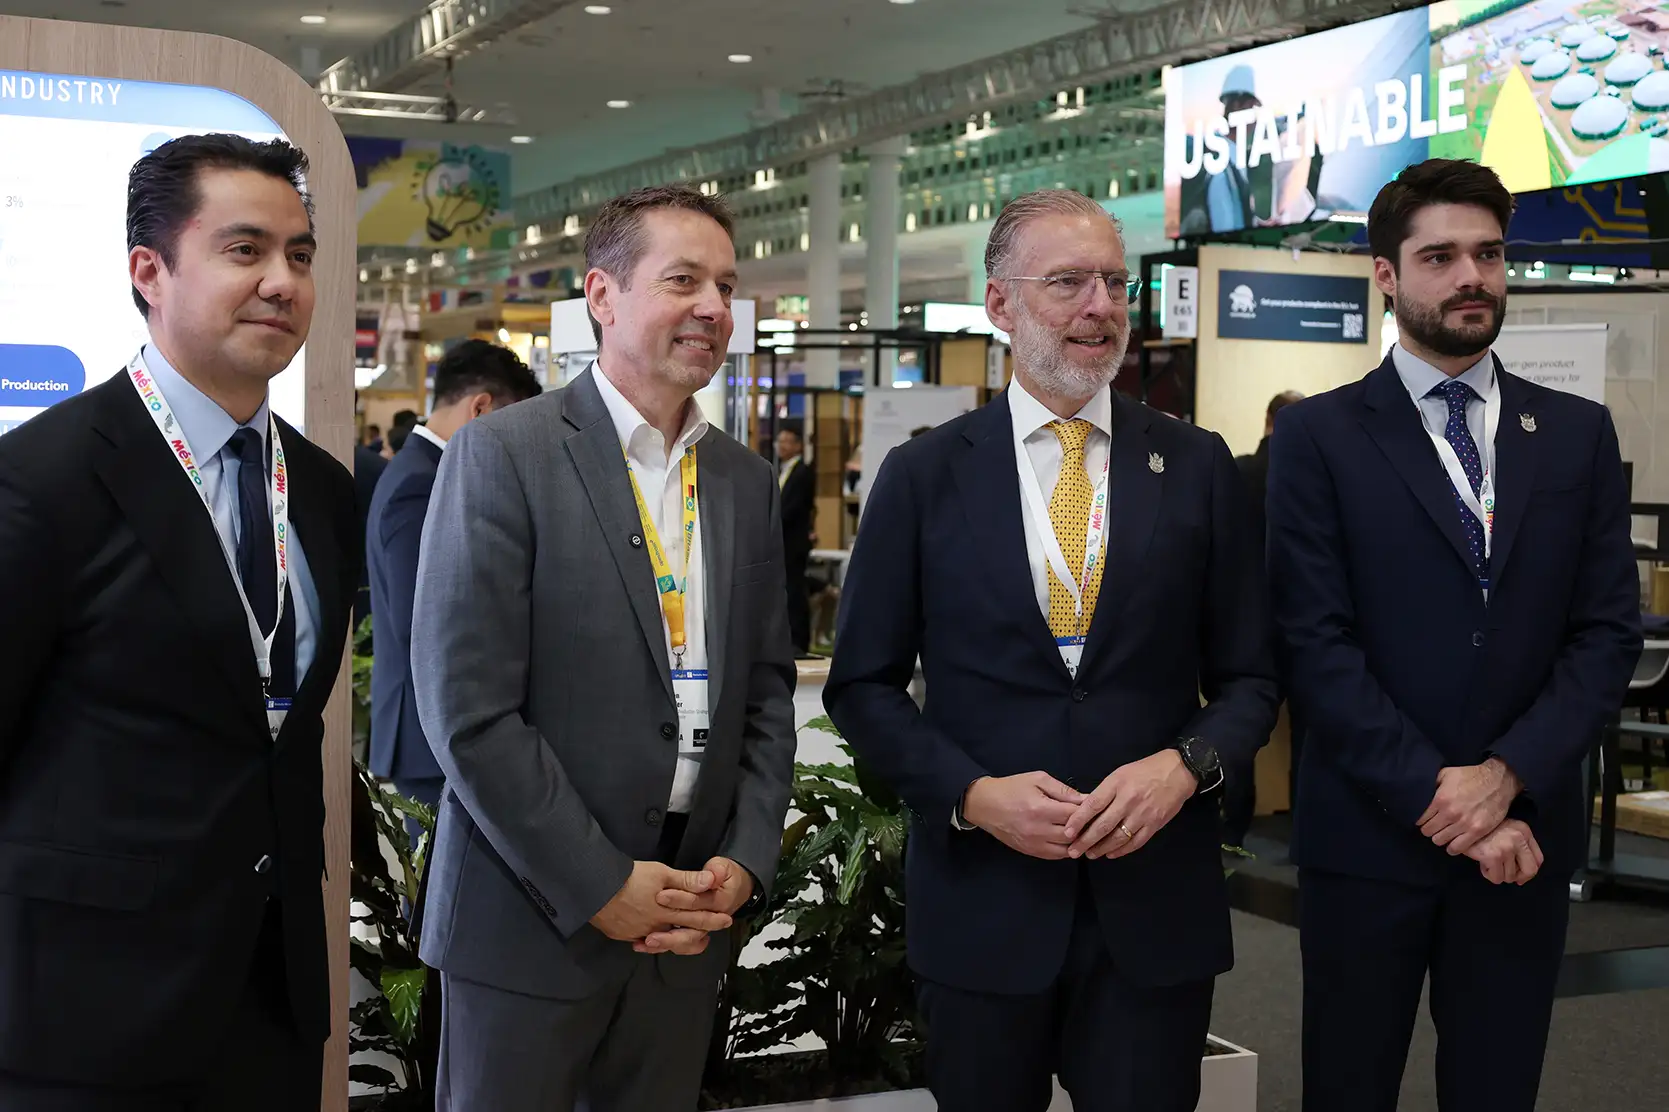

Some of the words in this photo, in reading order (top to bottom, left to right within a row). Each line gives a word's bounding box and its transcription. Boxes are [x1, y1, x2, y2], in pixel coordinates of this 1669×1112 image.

[1178, 64, 1468, 180] USTAINABLE
[1179, 278, 1189, 300] E
[1539, 359, 1575, 369] product
[1, 378, 69, 392] Production
